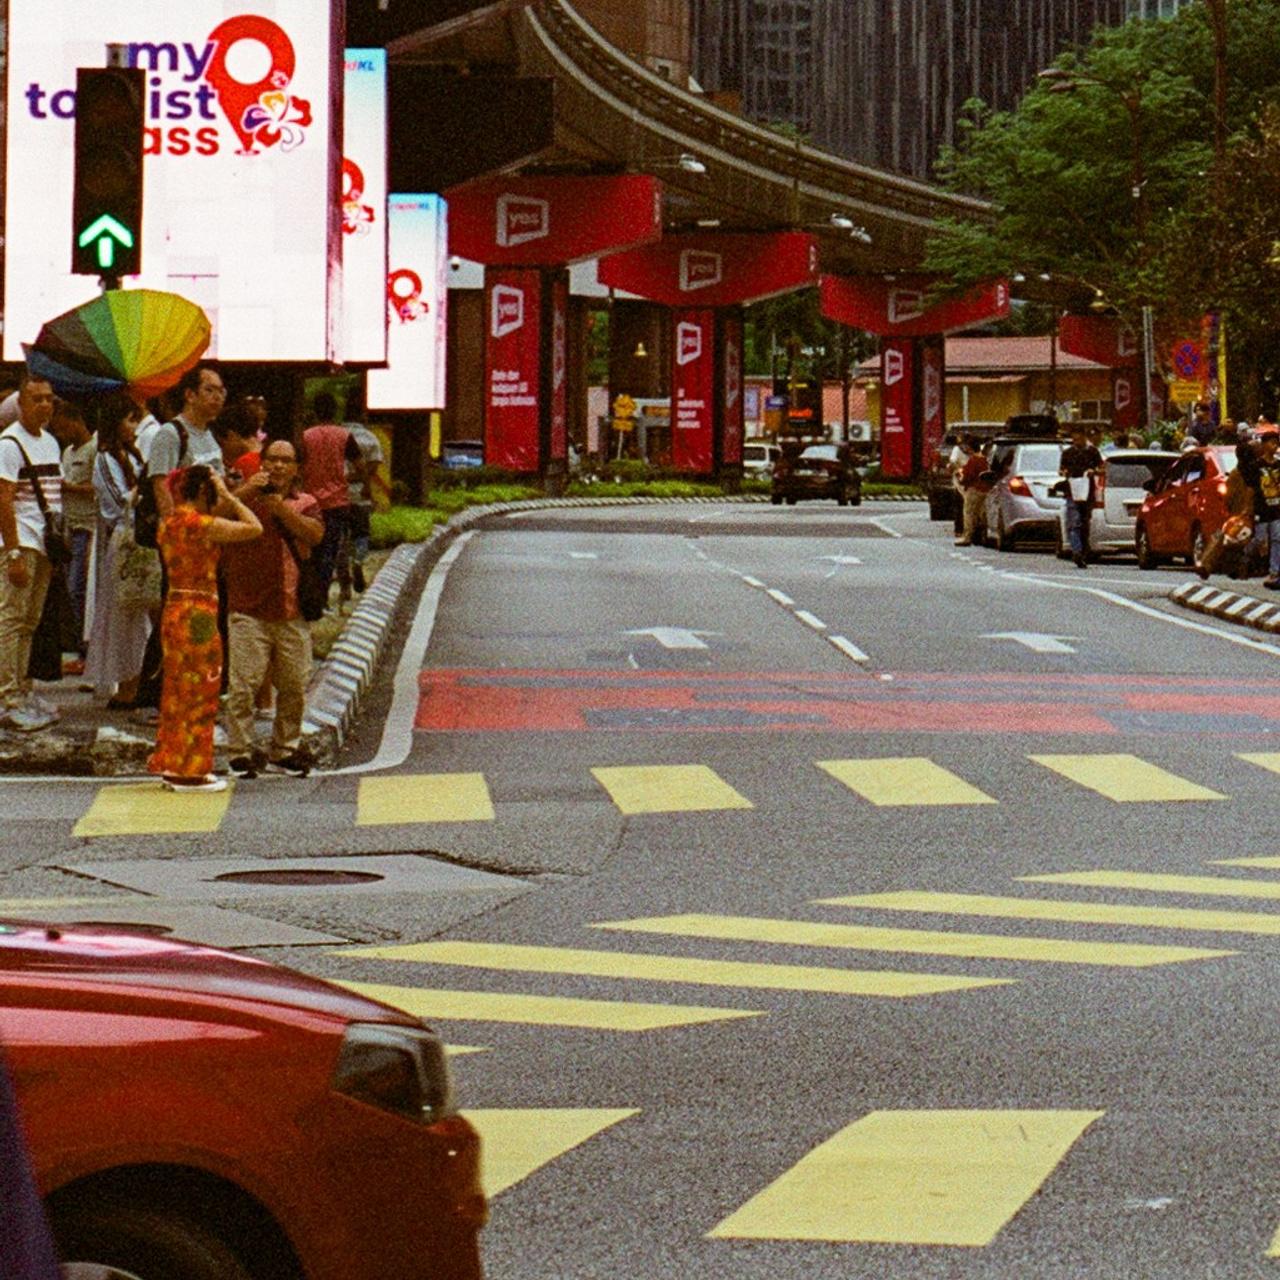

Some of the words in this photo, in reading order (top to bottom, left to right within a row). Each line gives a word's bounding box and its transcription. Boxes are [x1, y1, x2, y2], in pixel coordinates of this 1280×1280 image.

[128, 41, 216, 83] my
[25, 77, 217, 120] toist
[142, 126, 220, 157] ass
